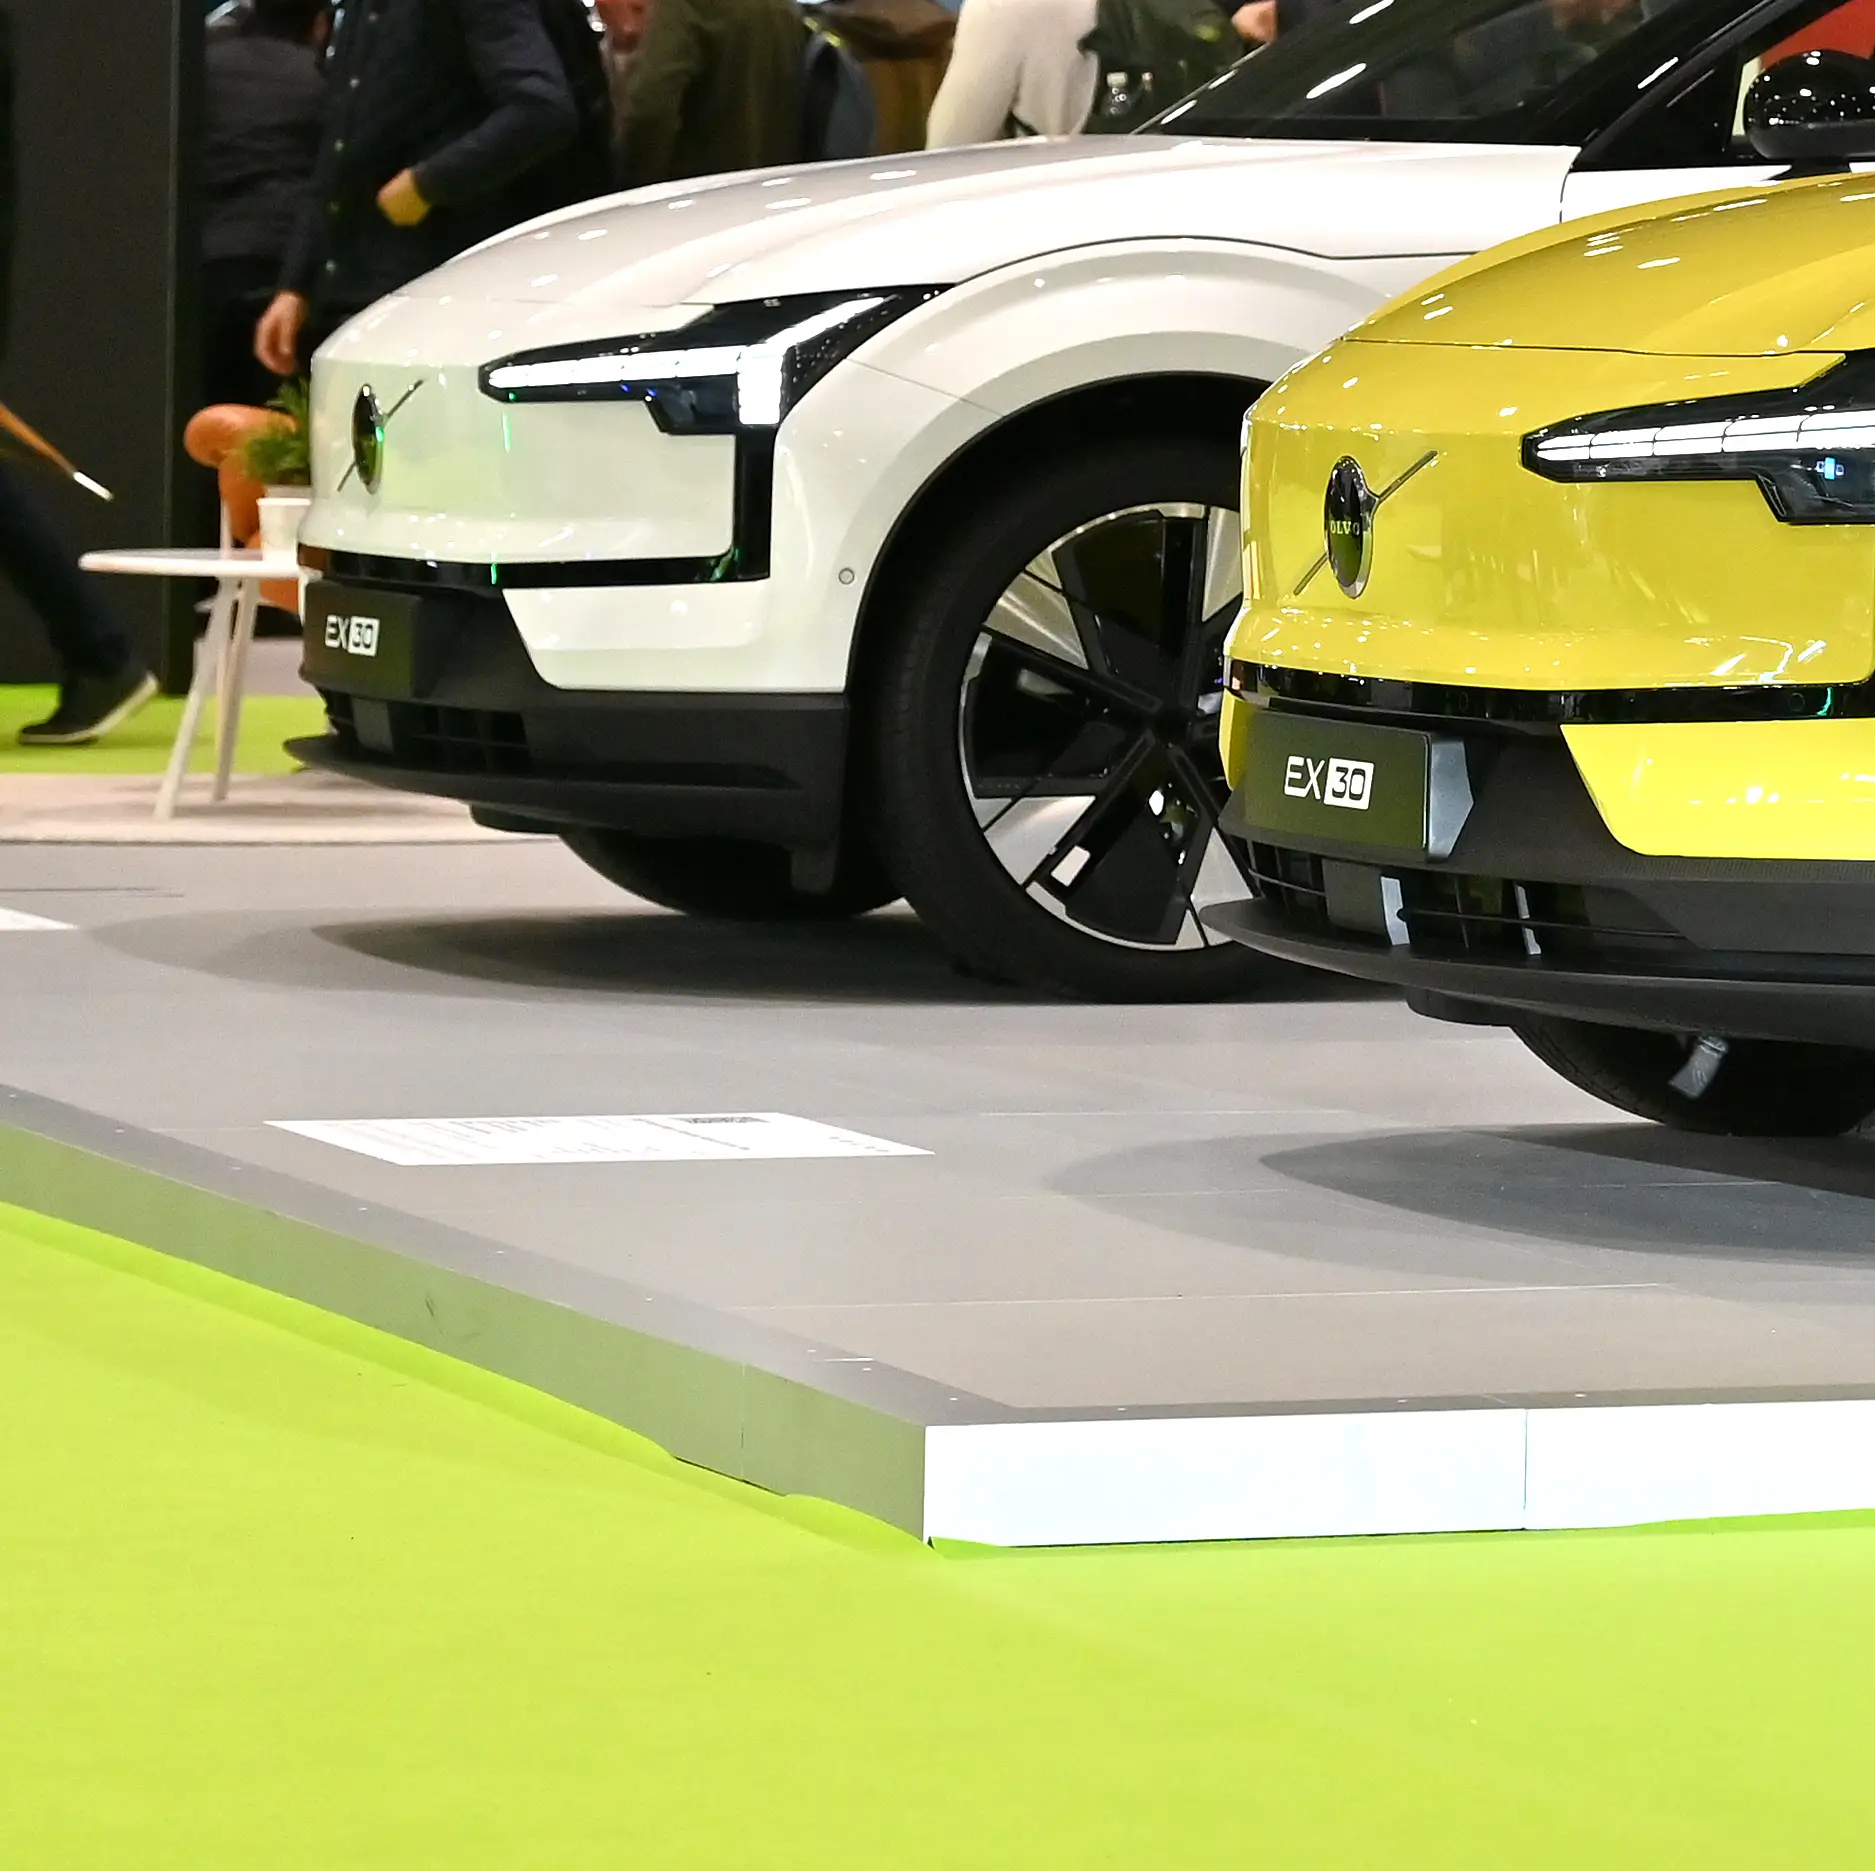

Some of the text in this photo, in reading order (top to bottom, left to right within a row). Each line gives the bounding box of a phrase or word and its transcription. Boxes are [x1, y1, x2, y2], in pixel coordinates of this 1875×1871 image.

[1329, 519, 1361, 536] OLVO
[325, 614, 380, 657] EX30
[1284, 755, 1375, 810] EX30
